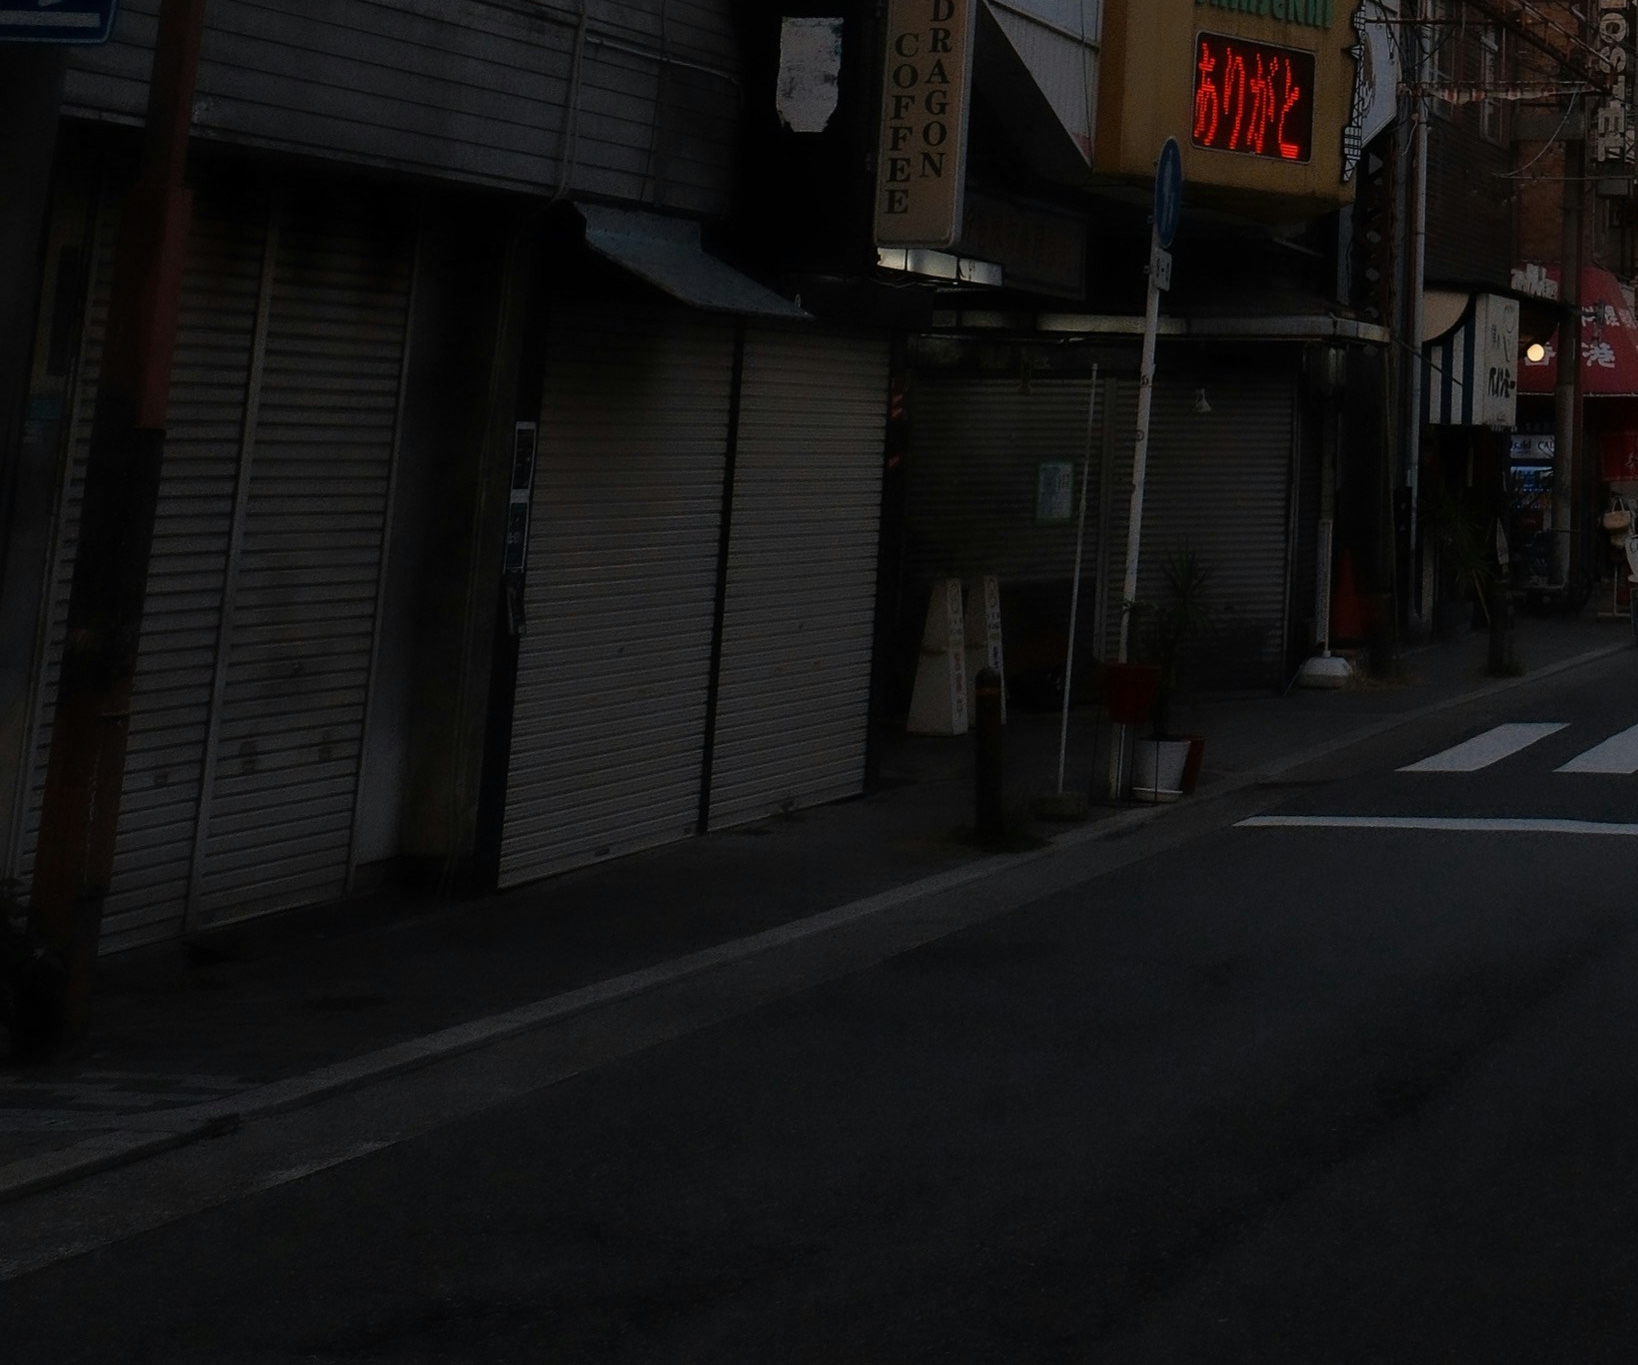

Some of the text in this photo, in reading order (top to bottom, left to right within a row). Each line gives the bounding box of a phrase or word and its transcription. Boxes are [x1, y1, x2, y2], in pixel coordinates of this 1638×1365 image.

[884, 32, 919, 215] COFFEE
[1193, 41, 1301, 159] ありがと
